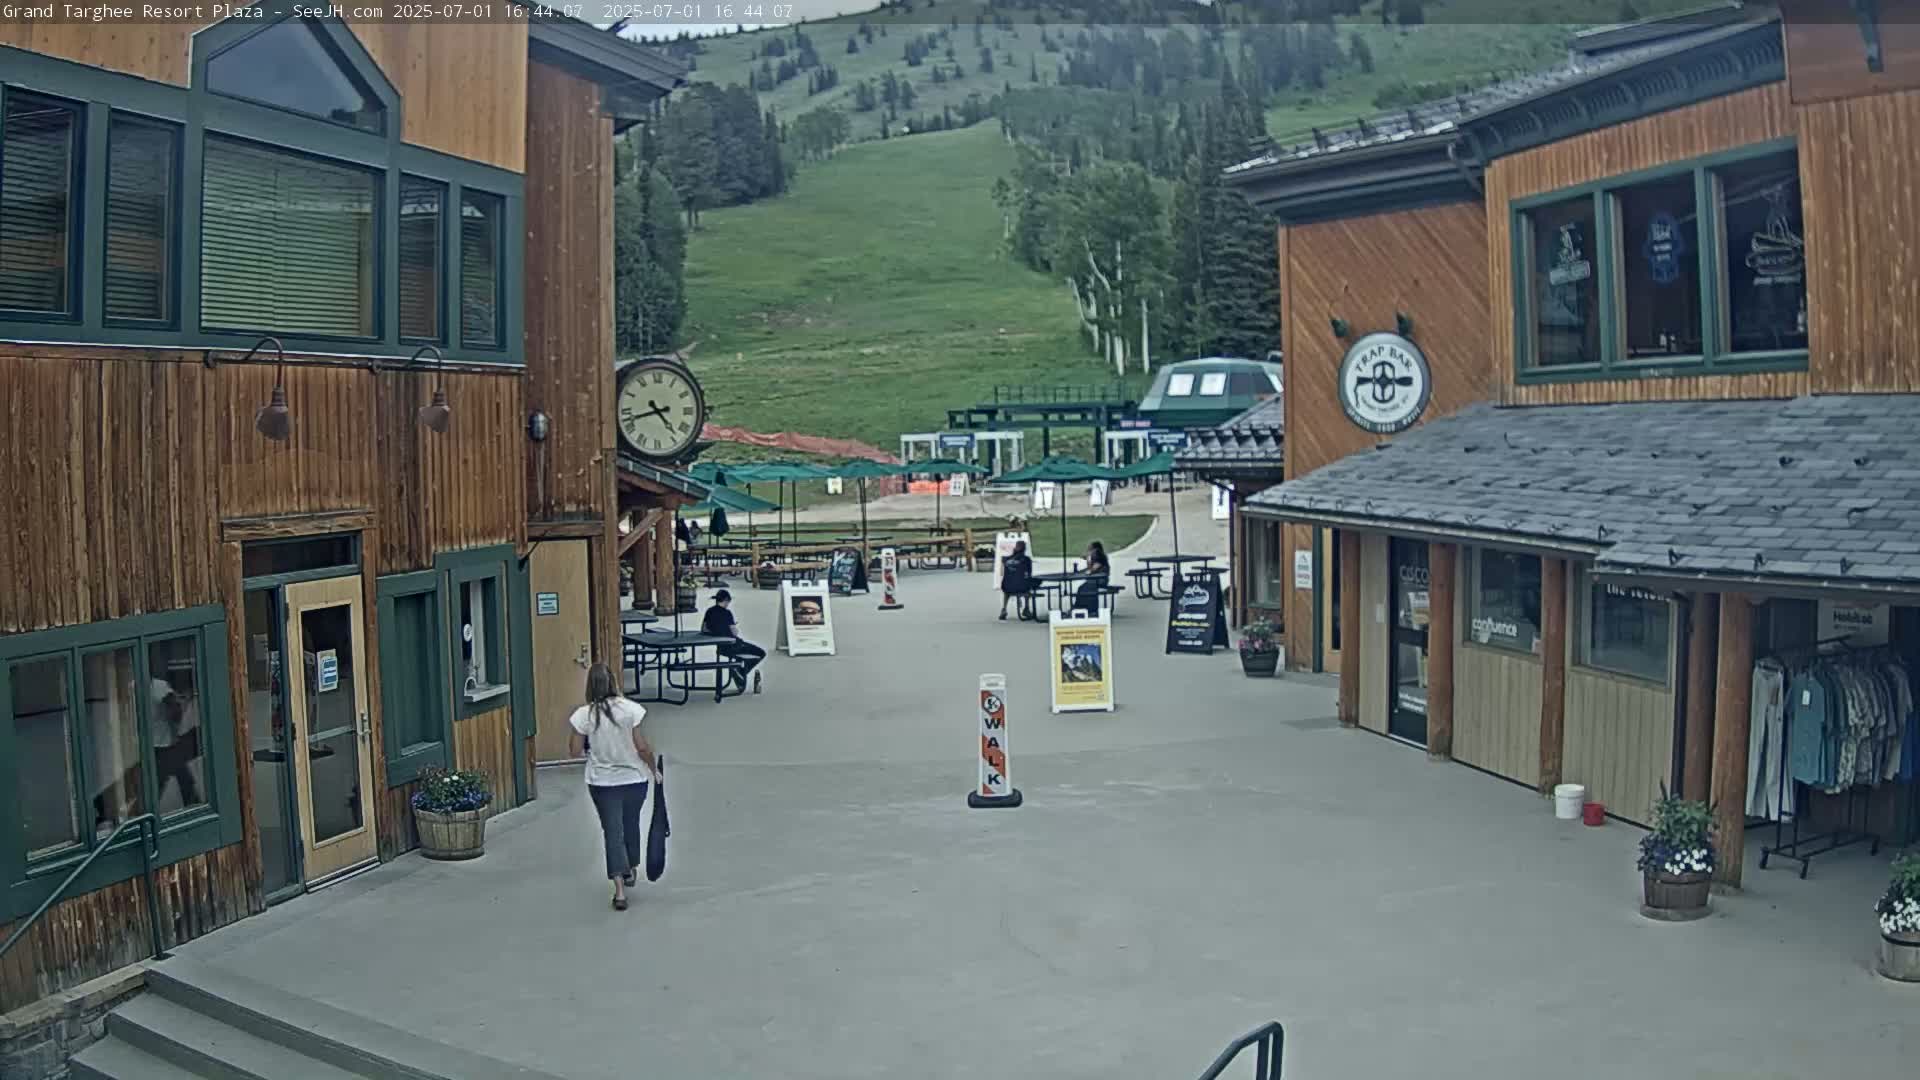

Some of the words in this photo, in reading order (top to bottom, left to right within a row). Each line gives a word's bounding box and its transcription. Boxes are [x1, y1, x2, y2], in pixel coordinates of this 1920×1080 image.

[1355, 345, 1385, 372] TRAP
[1389, 346, 1413, 371] BAR
[984, 717, 1002, 785] WALK
